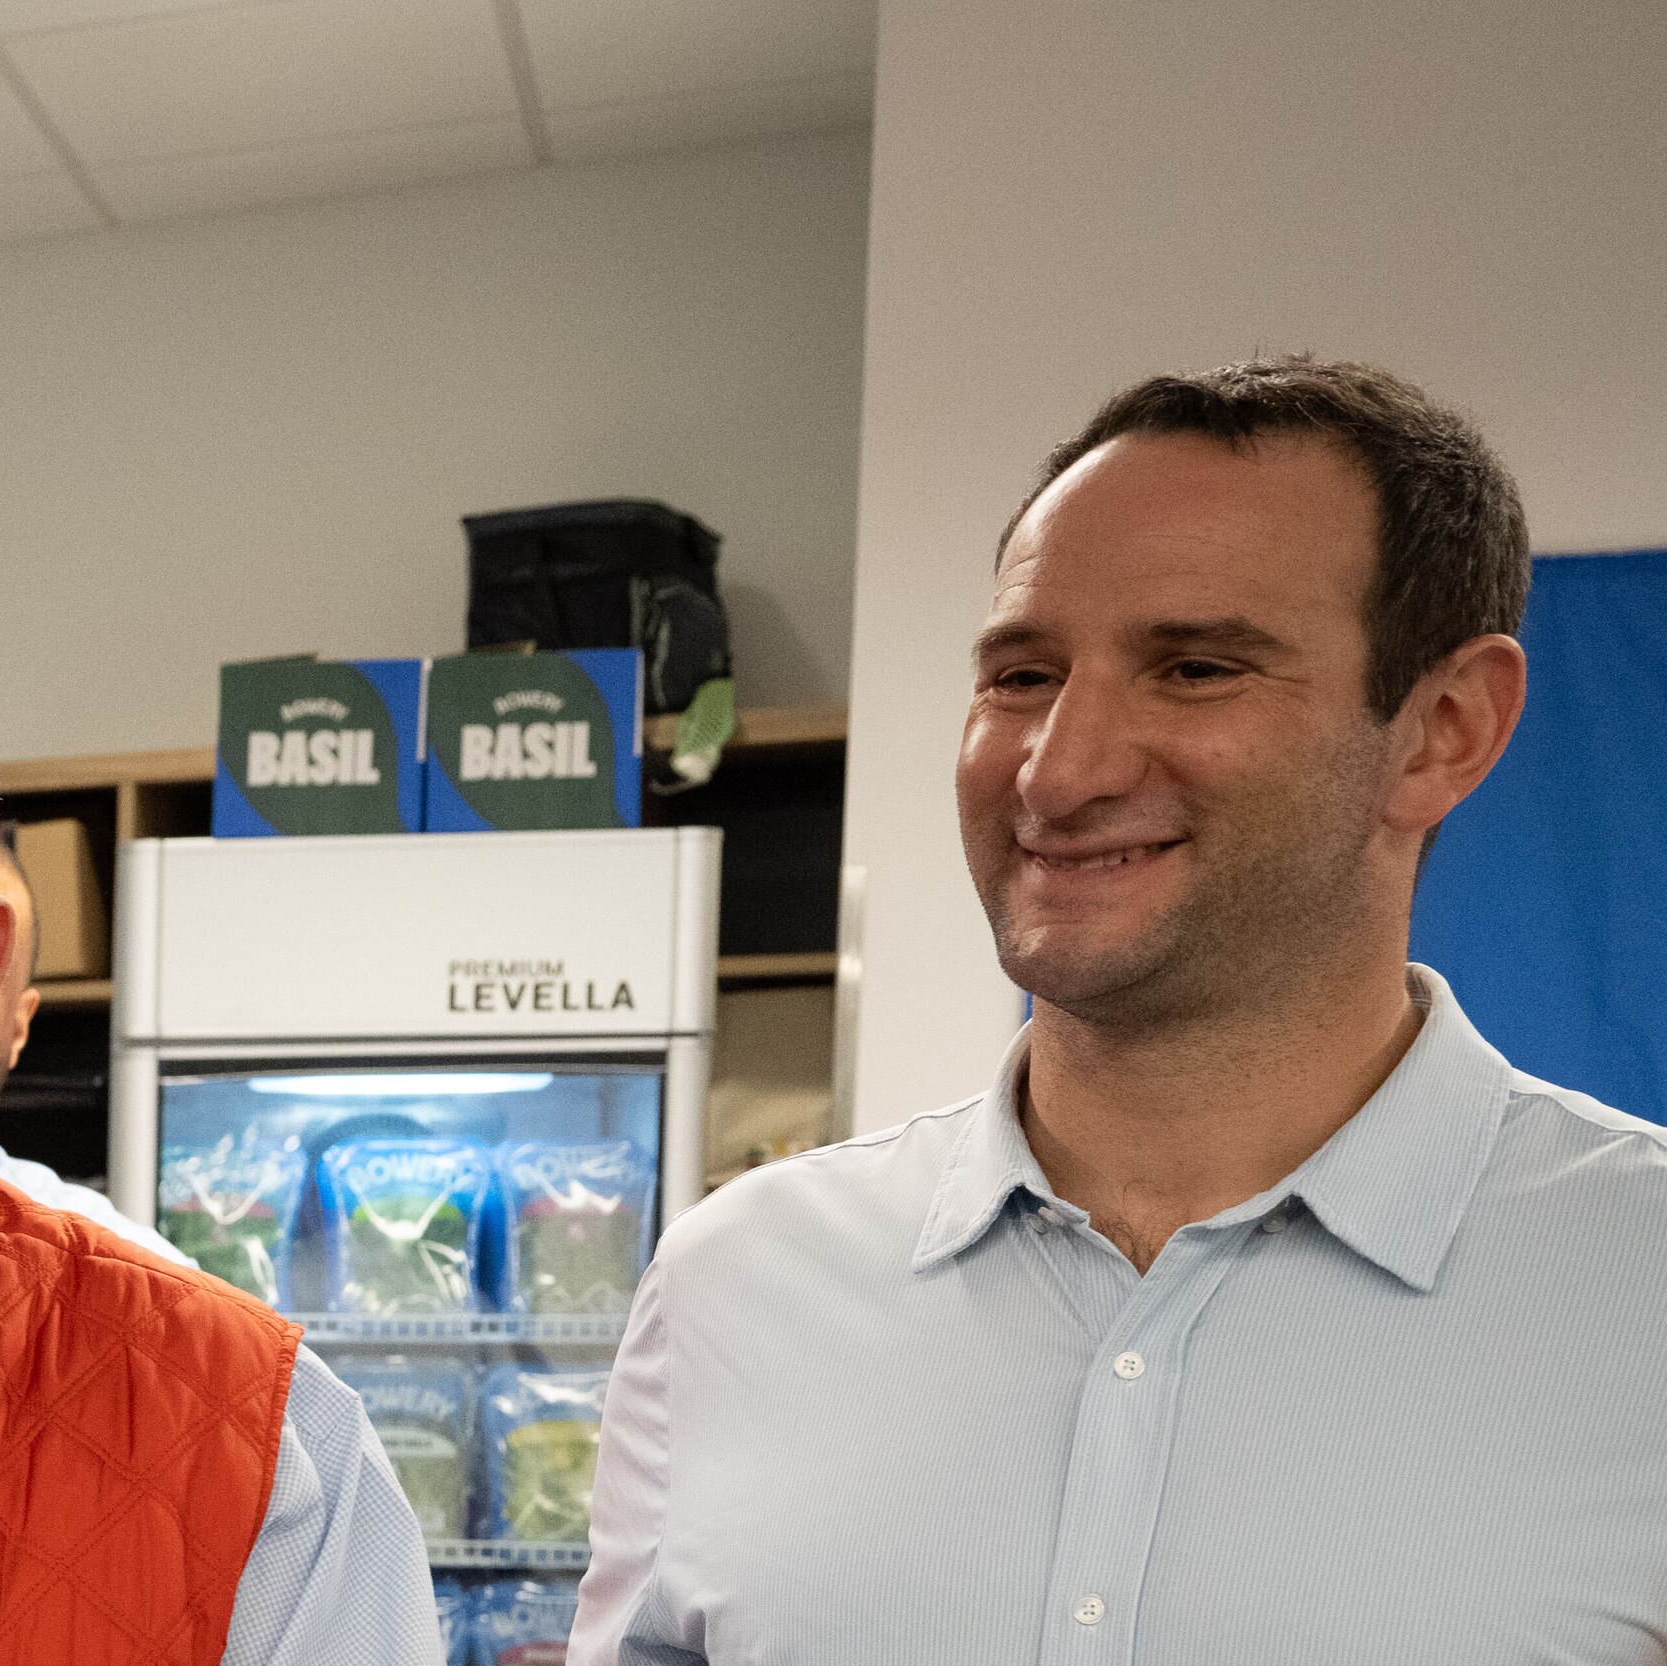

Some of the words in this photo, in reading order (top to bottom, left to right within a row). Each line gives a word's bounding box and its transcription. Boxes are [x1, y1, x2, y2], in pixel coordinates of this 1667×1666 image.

[246, 728, 381, 787] BASIL
[459, 720, 597, 781] BASIL
[449, 959, 565, 976] PREMIUM
[449, 980, 635, 1012] LEVELLA
